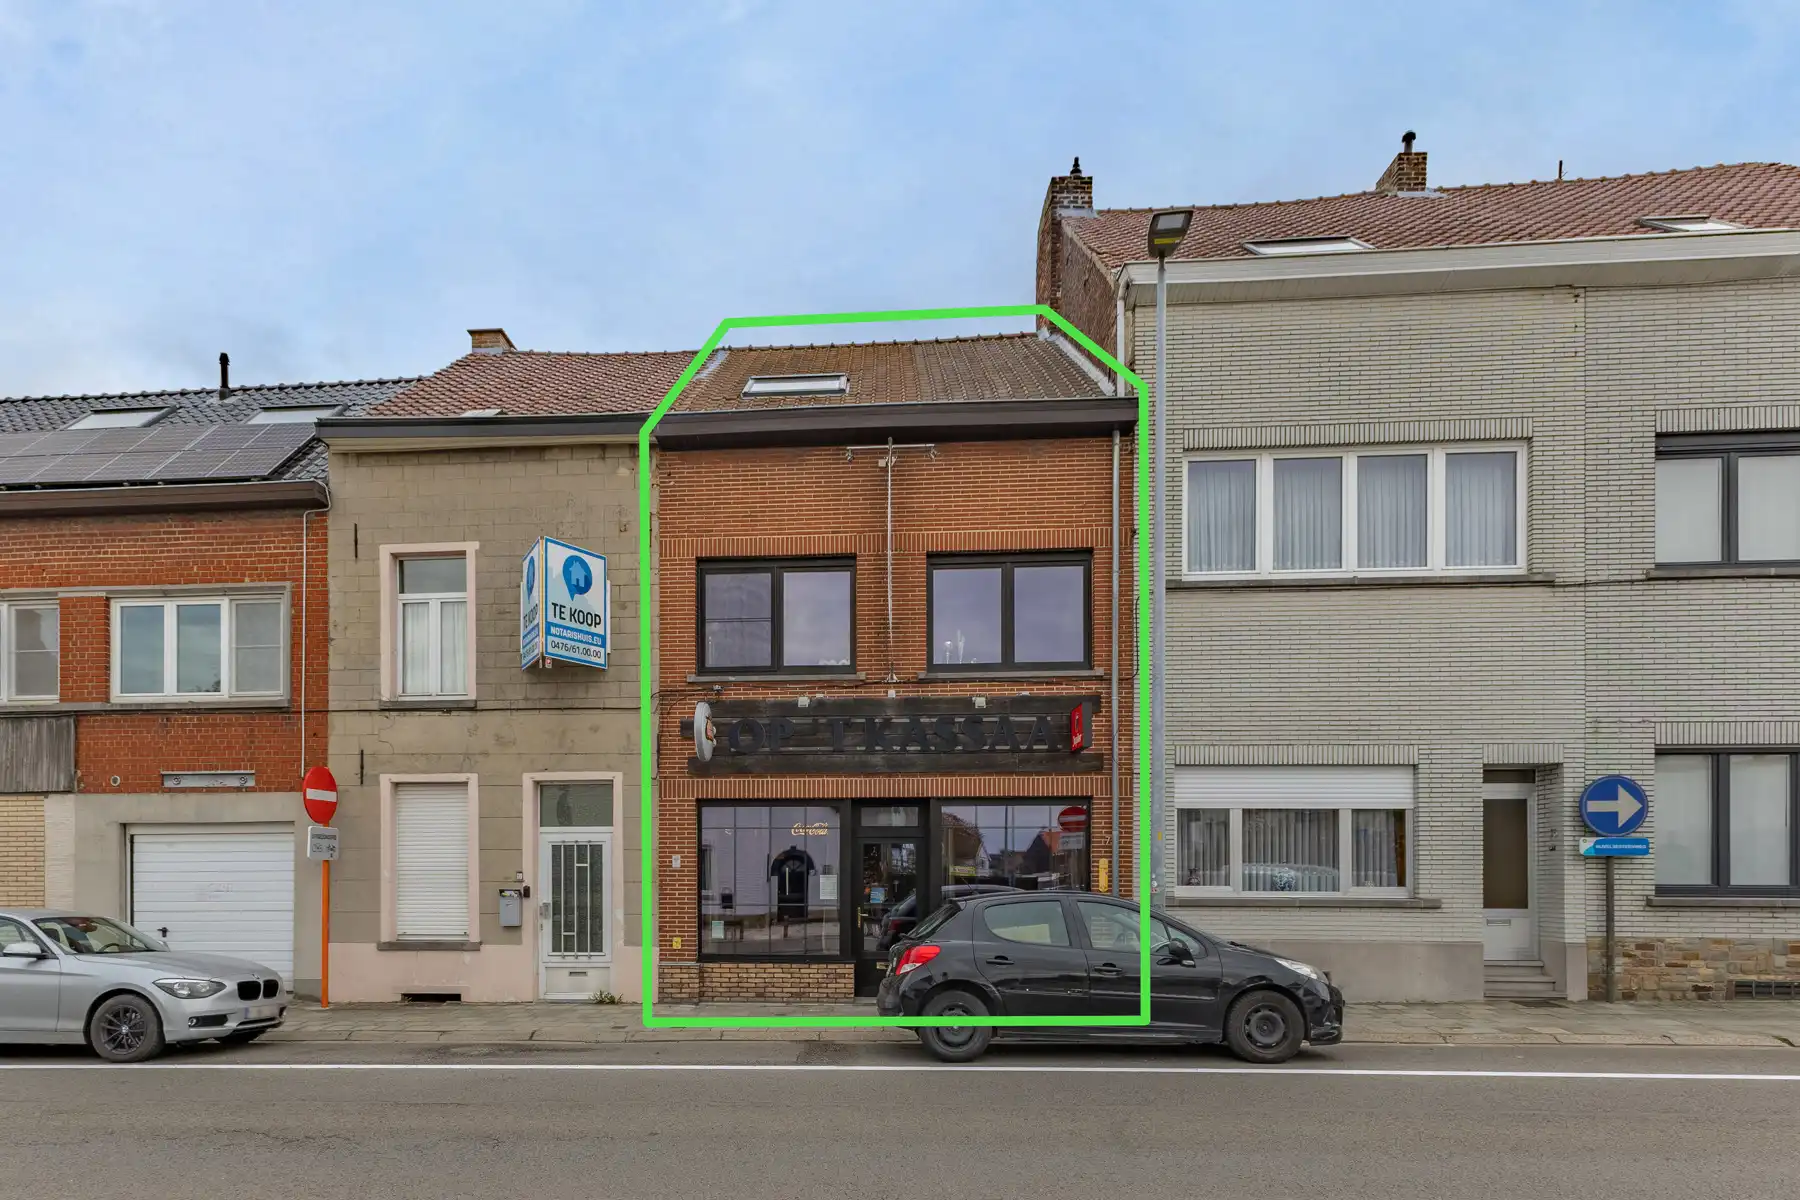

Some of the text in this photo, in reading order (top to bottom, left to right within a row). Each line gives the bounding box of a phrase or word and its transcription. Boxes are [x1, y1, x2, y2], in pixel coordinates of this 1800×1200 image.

[551, 602, 602, 628] TE KOOP
[550, 625, 602, 646] NOTARISHUIS.EU
[728, 717, 795, 753] OP
